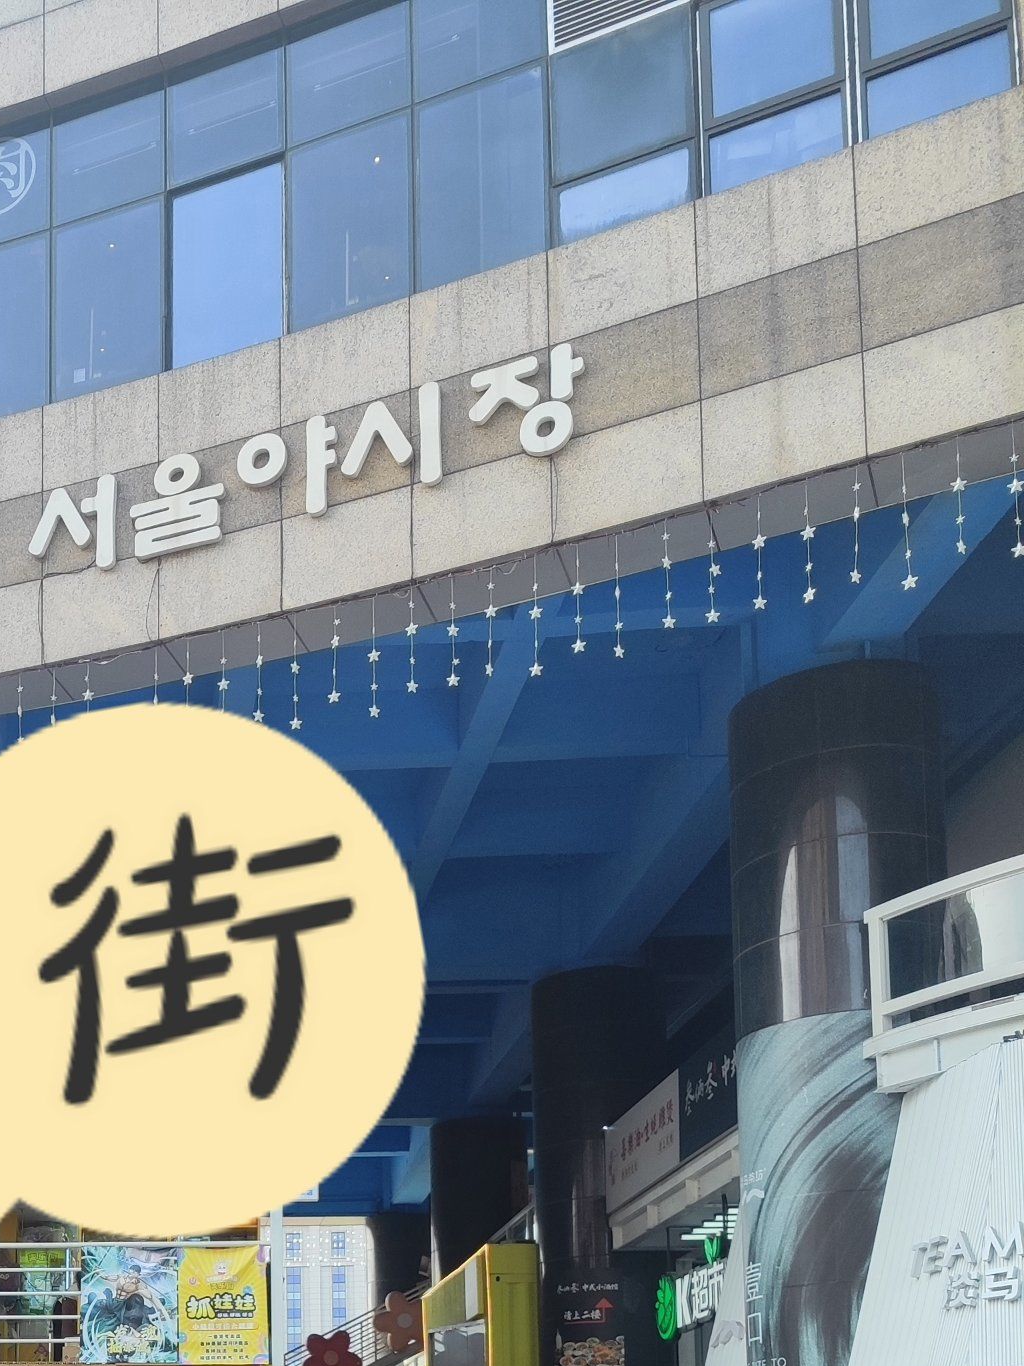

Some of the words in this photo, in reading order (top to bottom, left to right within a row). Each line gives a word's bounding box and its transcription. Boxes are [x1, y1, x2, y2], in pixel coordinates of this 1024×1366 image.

[27, 342, 585, 571] 서울야시장
[186, 1293, 256, 1320] 抓娃娃
